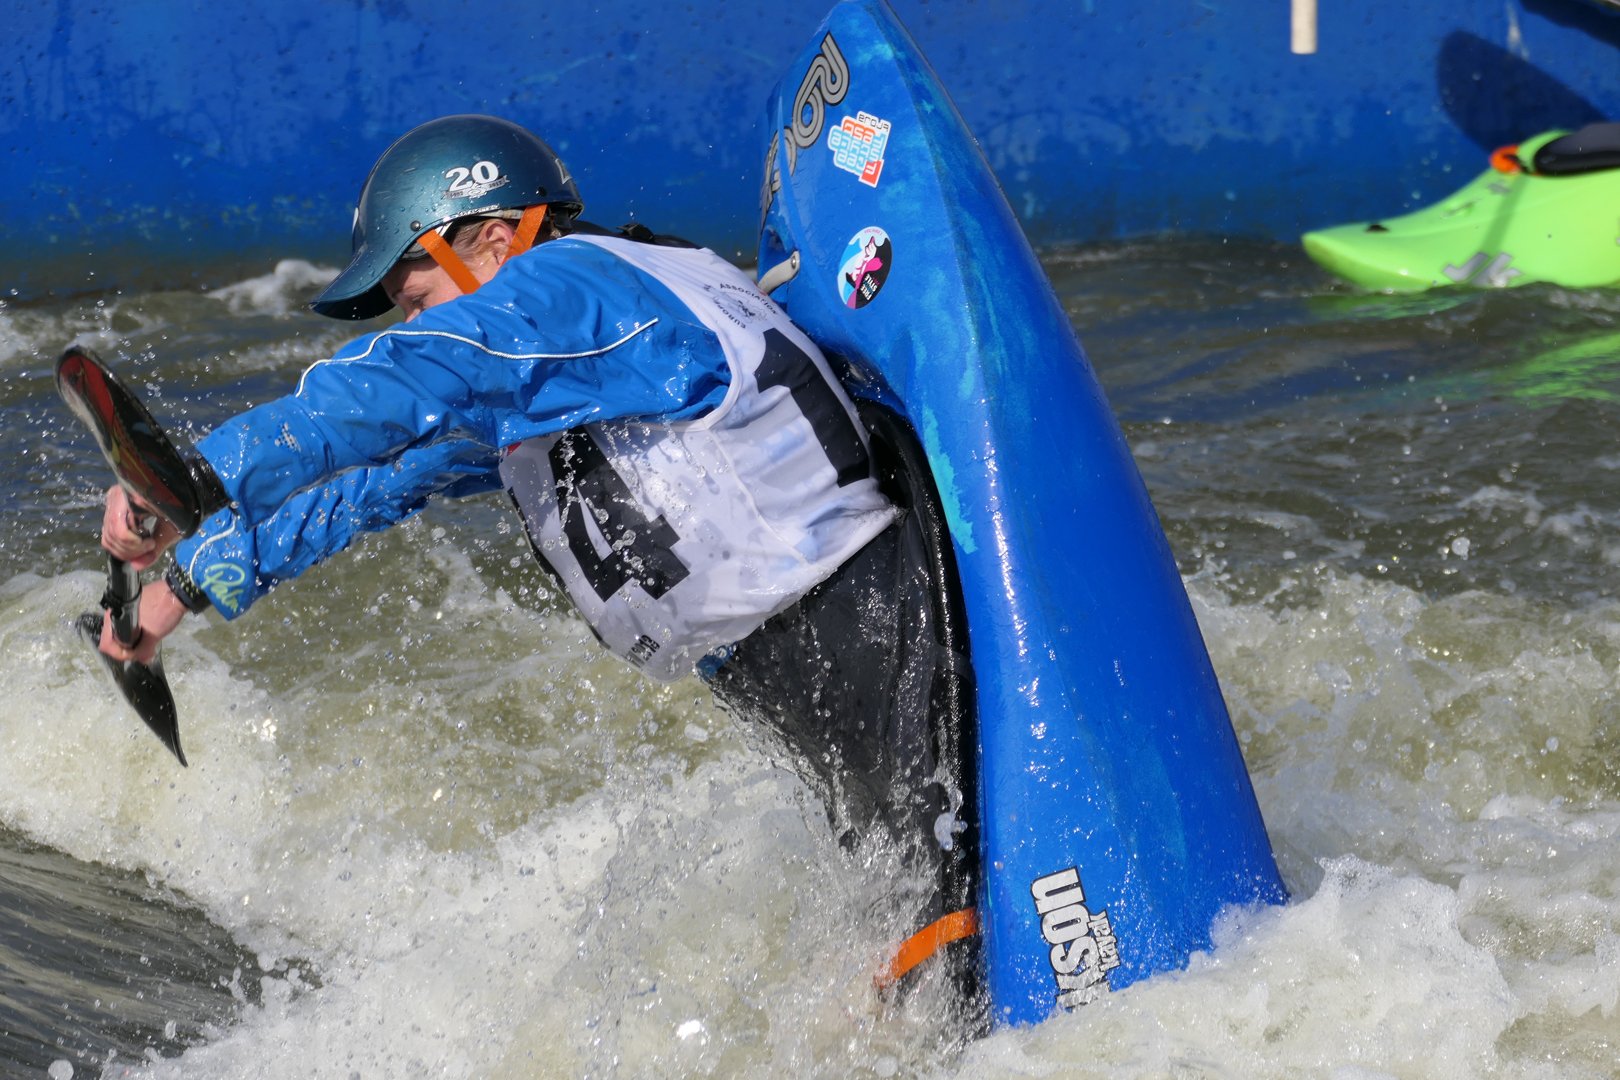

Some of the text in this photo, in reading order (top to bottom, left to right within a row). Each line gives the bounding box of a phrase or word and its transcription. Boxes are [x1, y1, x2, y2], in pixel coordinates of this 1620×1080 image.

[445, 161, 499, 192] 20
[860, 283, 872, 300] FREE
[864, 273, 877, 291] STYLE
[548, 425, 690, 602] 4
[1030, 866, 1112, 1009] kson
[1087, 909, 1121, 972] kayak
